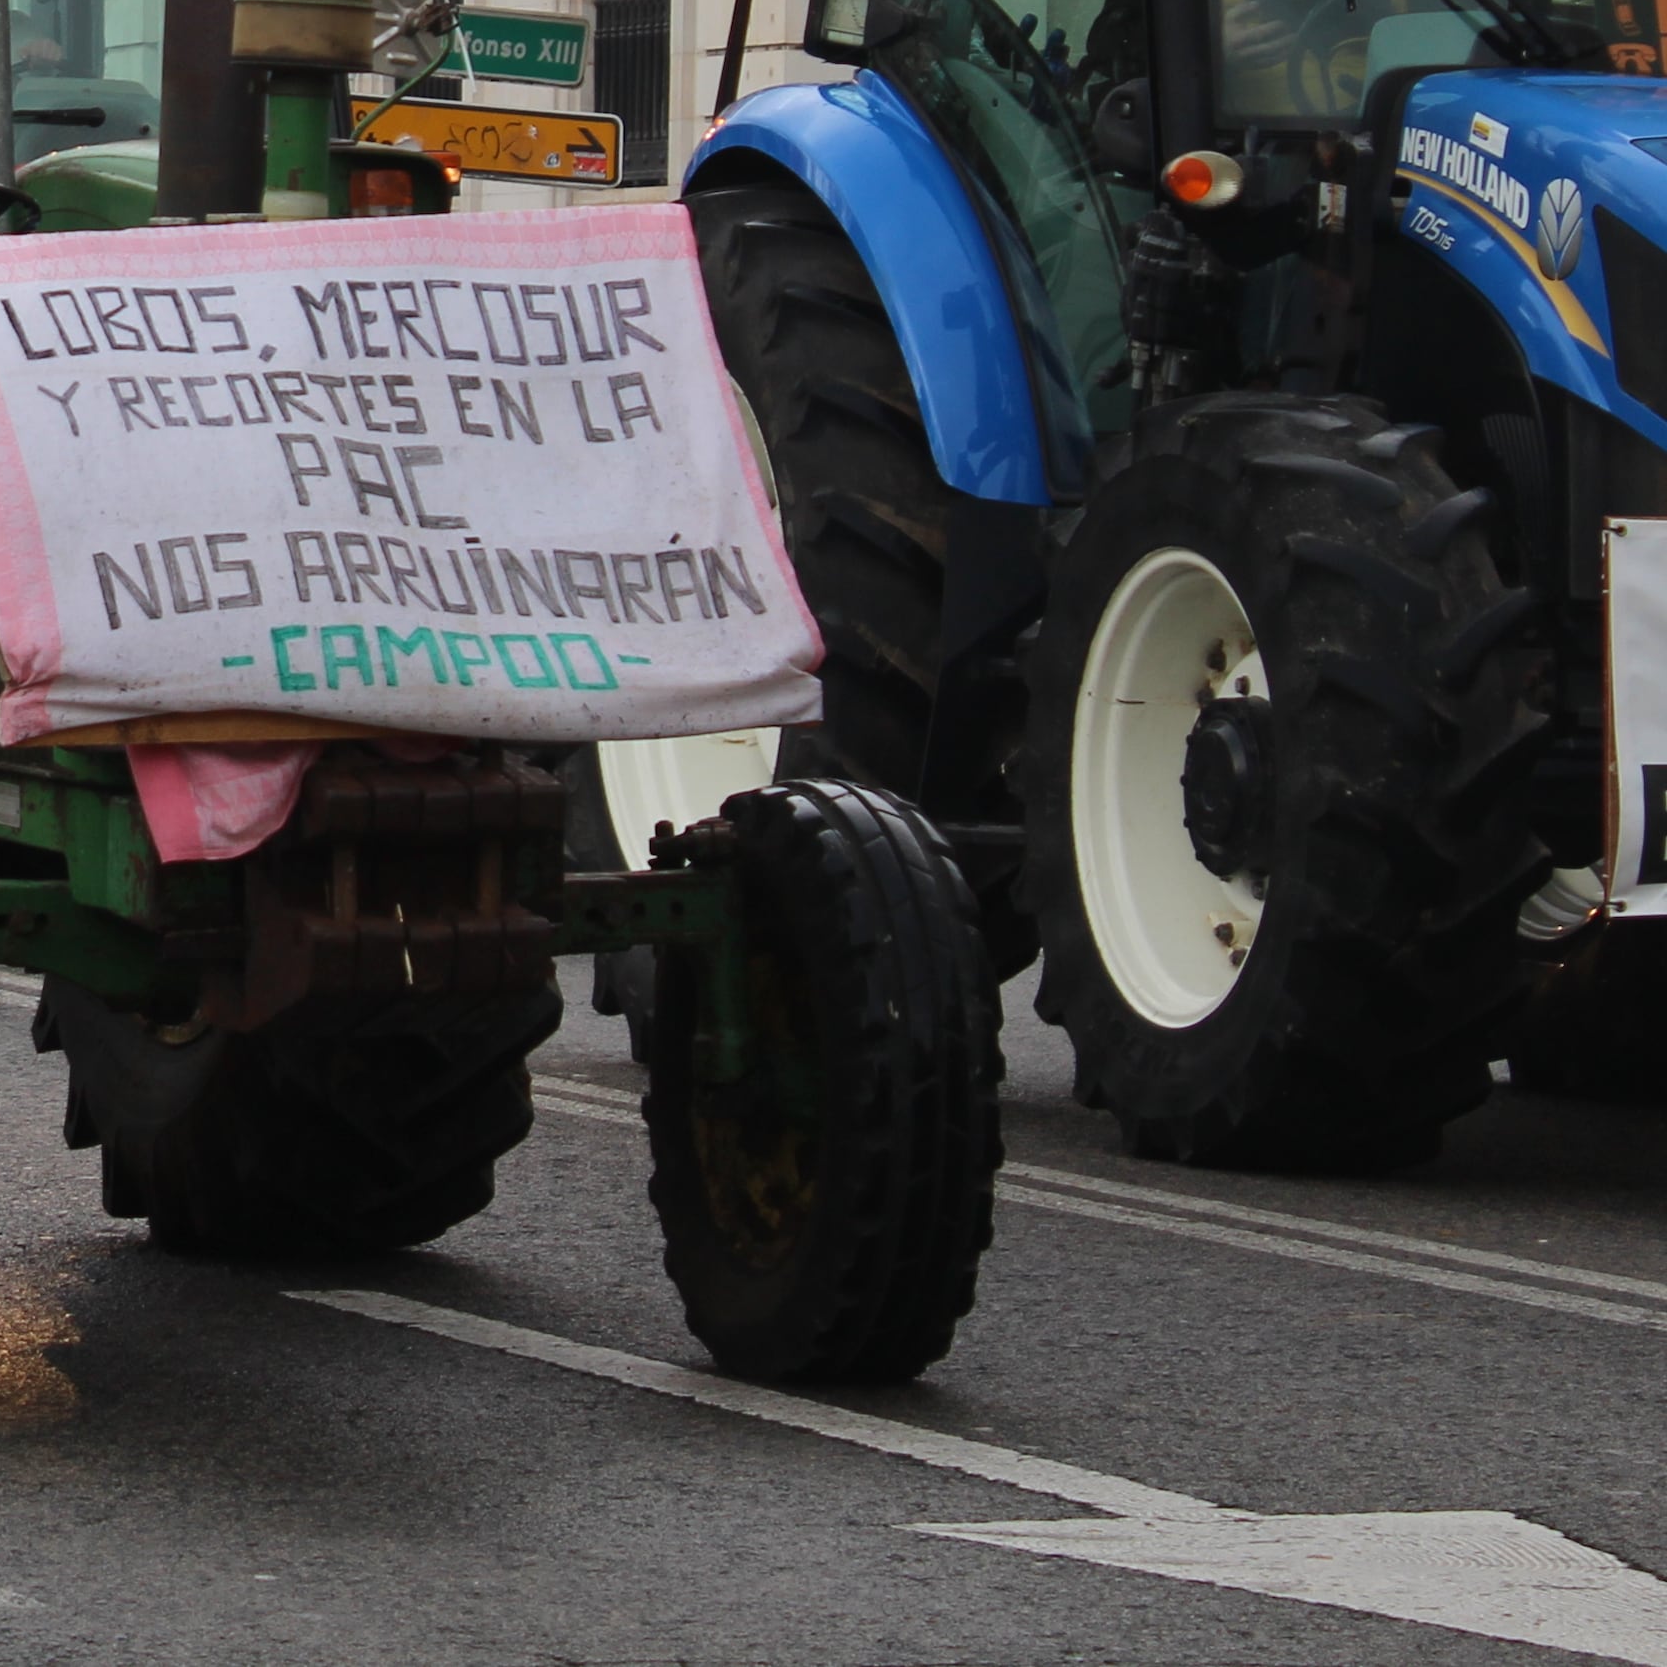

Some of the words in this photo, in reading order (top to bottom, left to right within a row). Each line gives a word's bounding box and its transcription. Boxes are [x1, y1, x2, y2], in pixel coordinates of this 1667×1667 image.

[442, 31, 527, 59] lfonso
[537, 37, 579, 65] XIII
[1401, 126, 1444, 173] NEW
[1441, 137, 1531, 230] HOLLAND
[294, 278, 666, 366] MERCOSUR
[37, 380, 81, 437] Y
[107, 370, 427, 433] RECORTES
[447, 373, 544, 446] EN
[571, 371, 663, 443] LA
[275, 433, 470, 529] PAC
[93, 533, 262, 630] NOS
